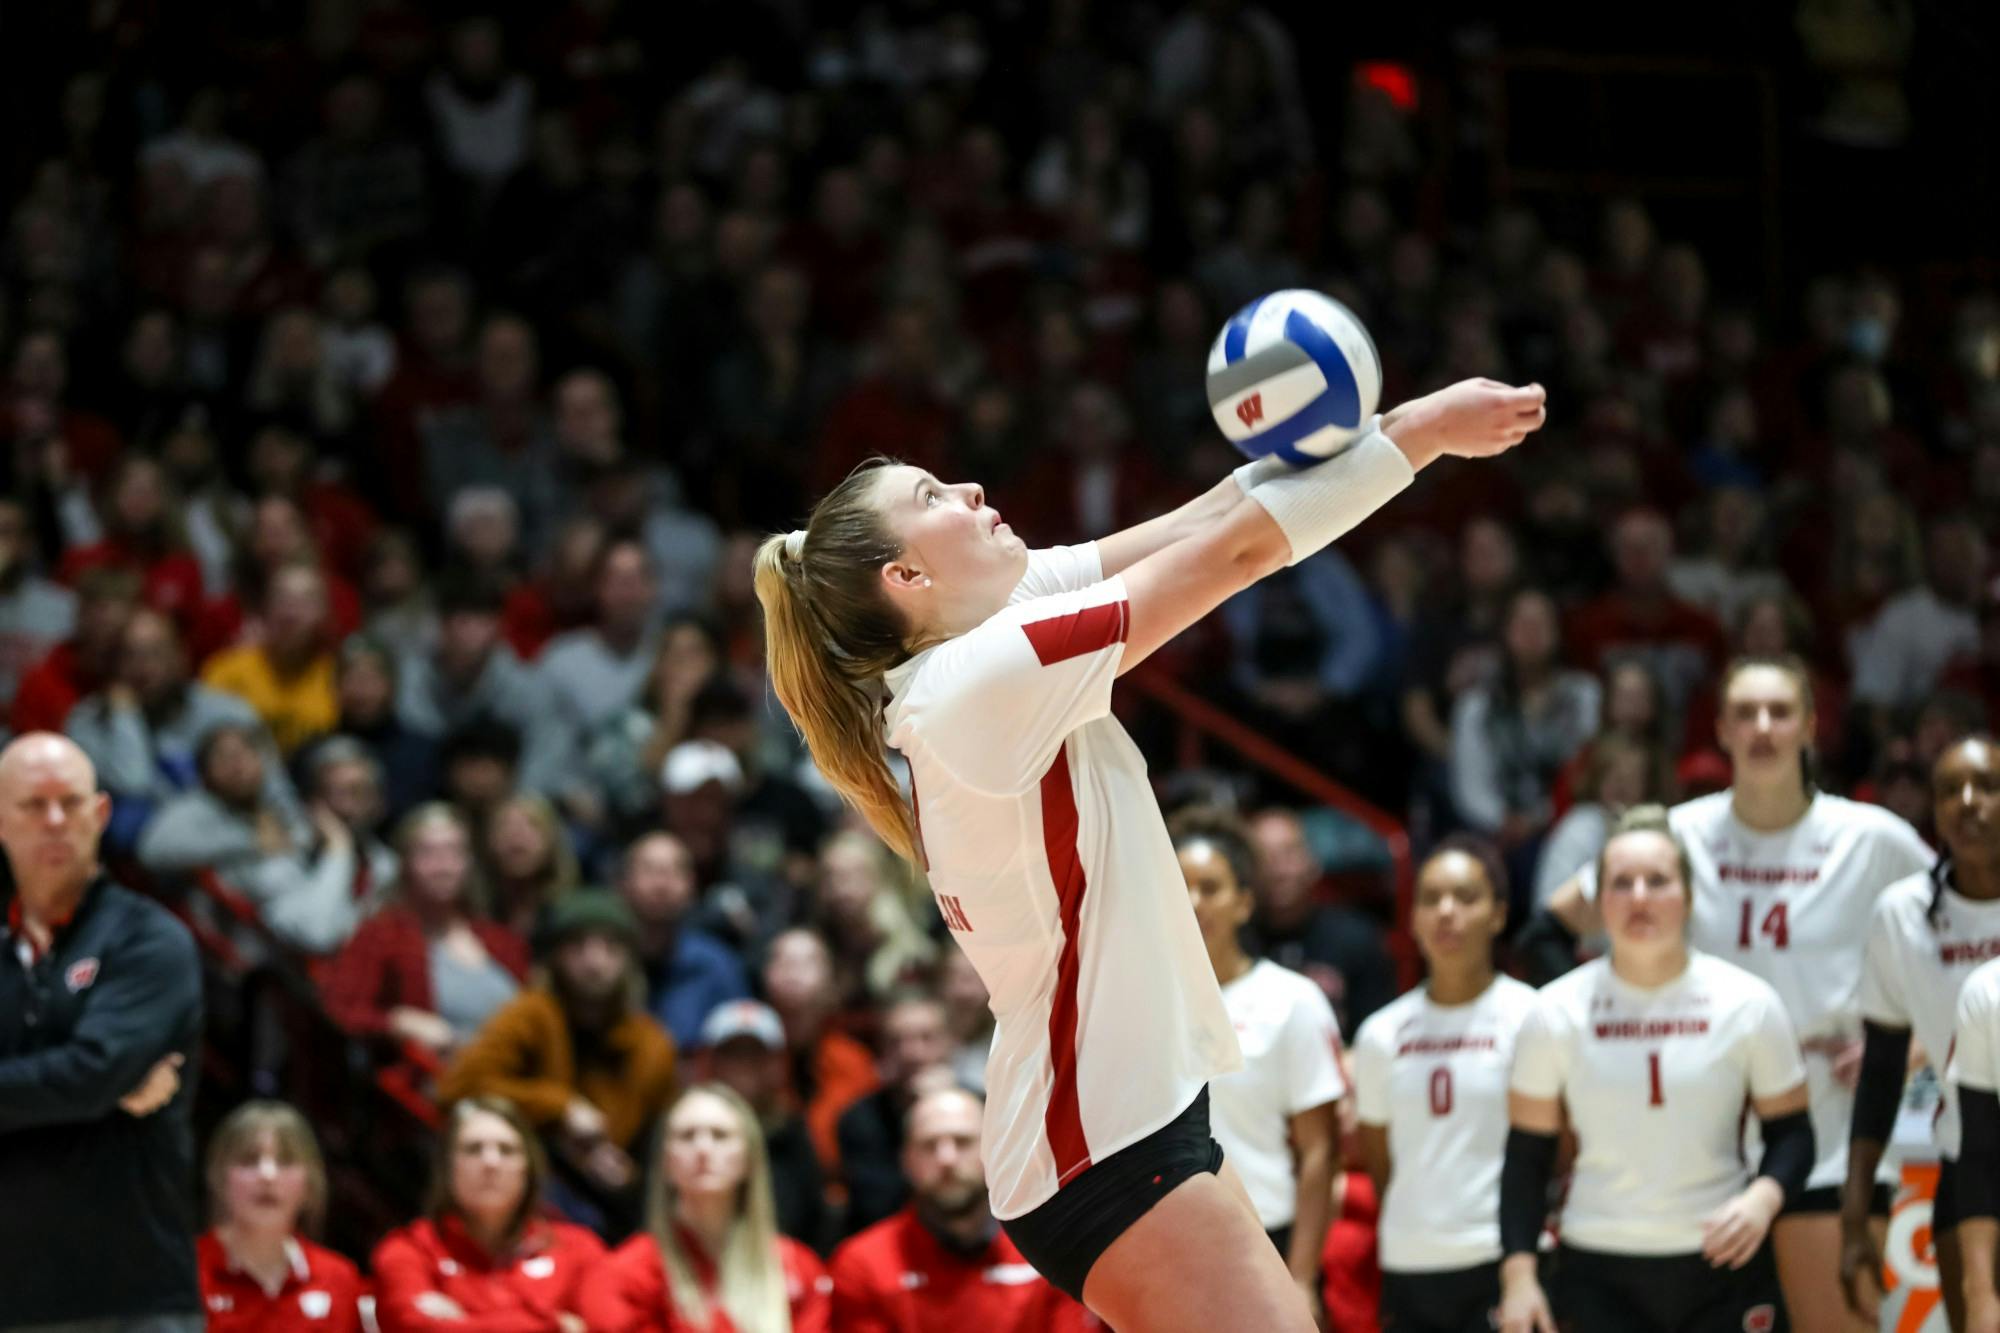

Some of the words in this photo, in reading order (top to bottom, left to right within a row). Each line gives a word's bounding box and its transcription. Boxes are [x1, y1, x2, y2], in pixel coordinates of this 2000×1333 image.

[1236, 391, 1264, 429] W
[1739, 899, 1790, 950] 14
[1429, 1067, 1453, 1117] 0
[1648, 1053, 1665, 1106] 1
